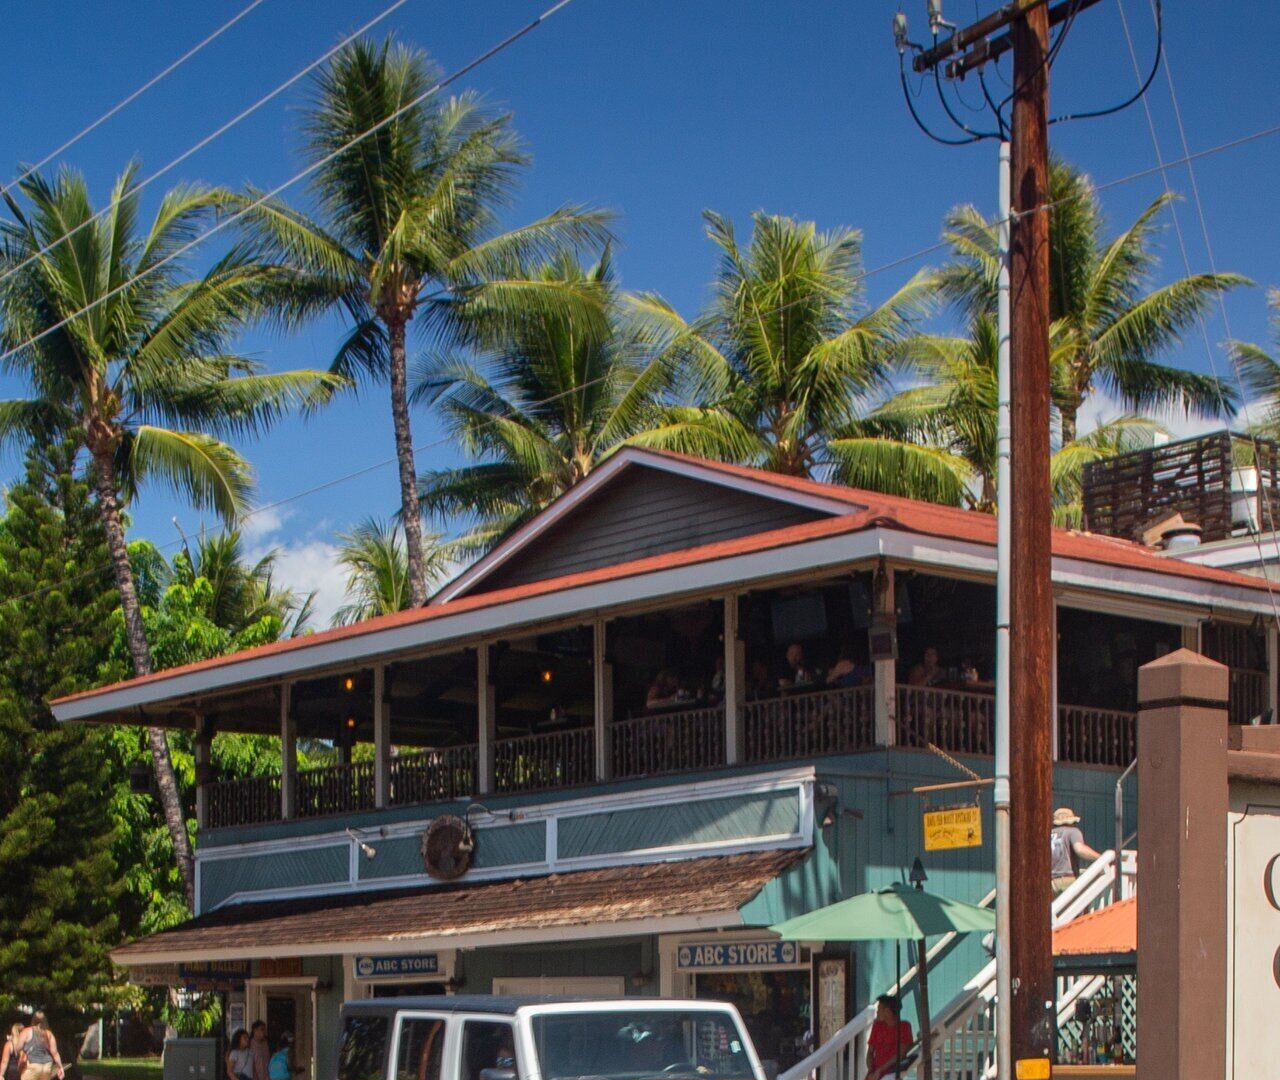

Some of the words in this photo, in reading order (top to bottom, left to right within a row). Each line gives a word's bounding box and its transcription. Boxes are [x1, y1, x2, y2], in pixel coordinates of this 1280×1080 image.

[693, 945, 724, 966] ABC
[728, 943, 778, 966] STORE
[375, 960, 398, 972] ABC
[401, 957, 437, 971] STORE
